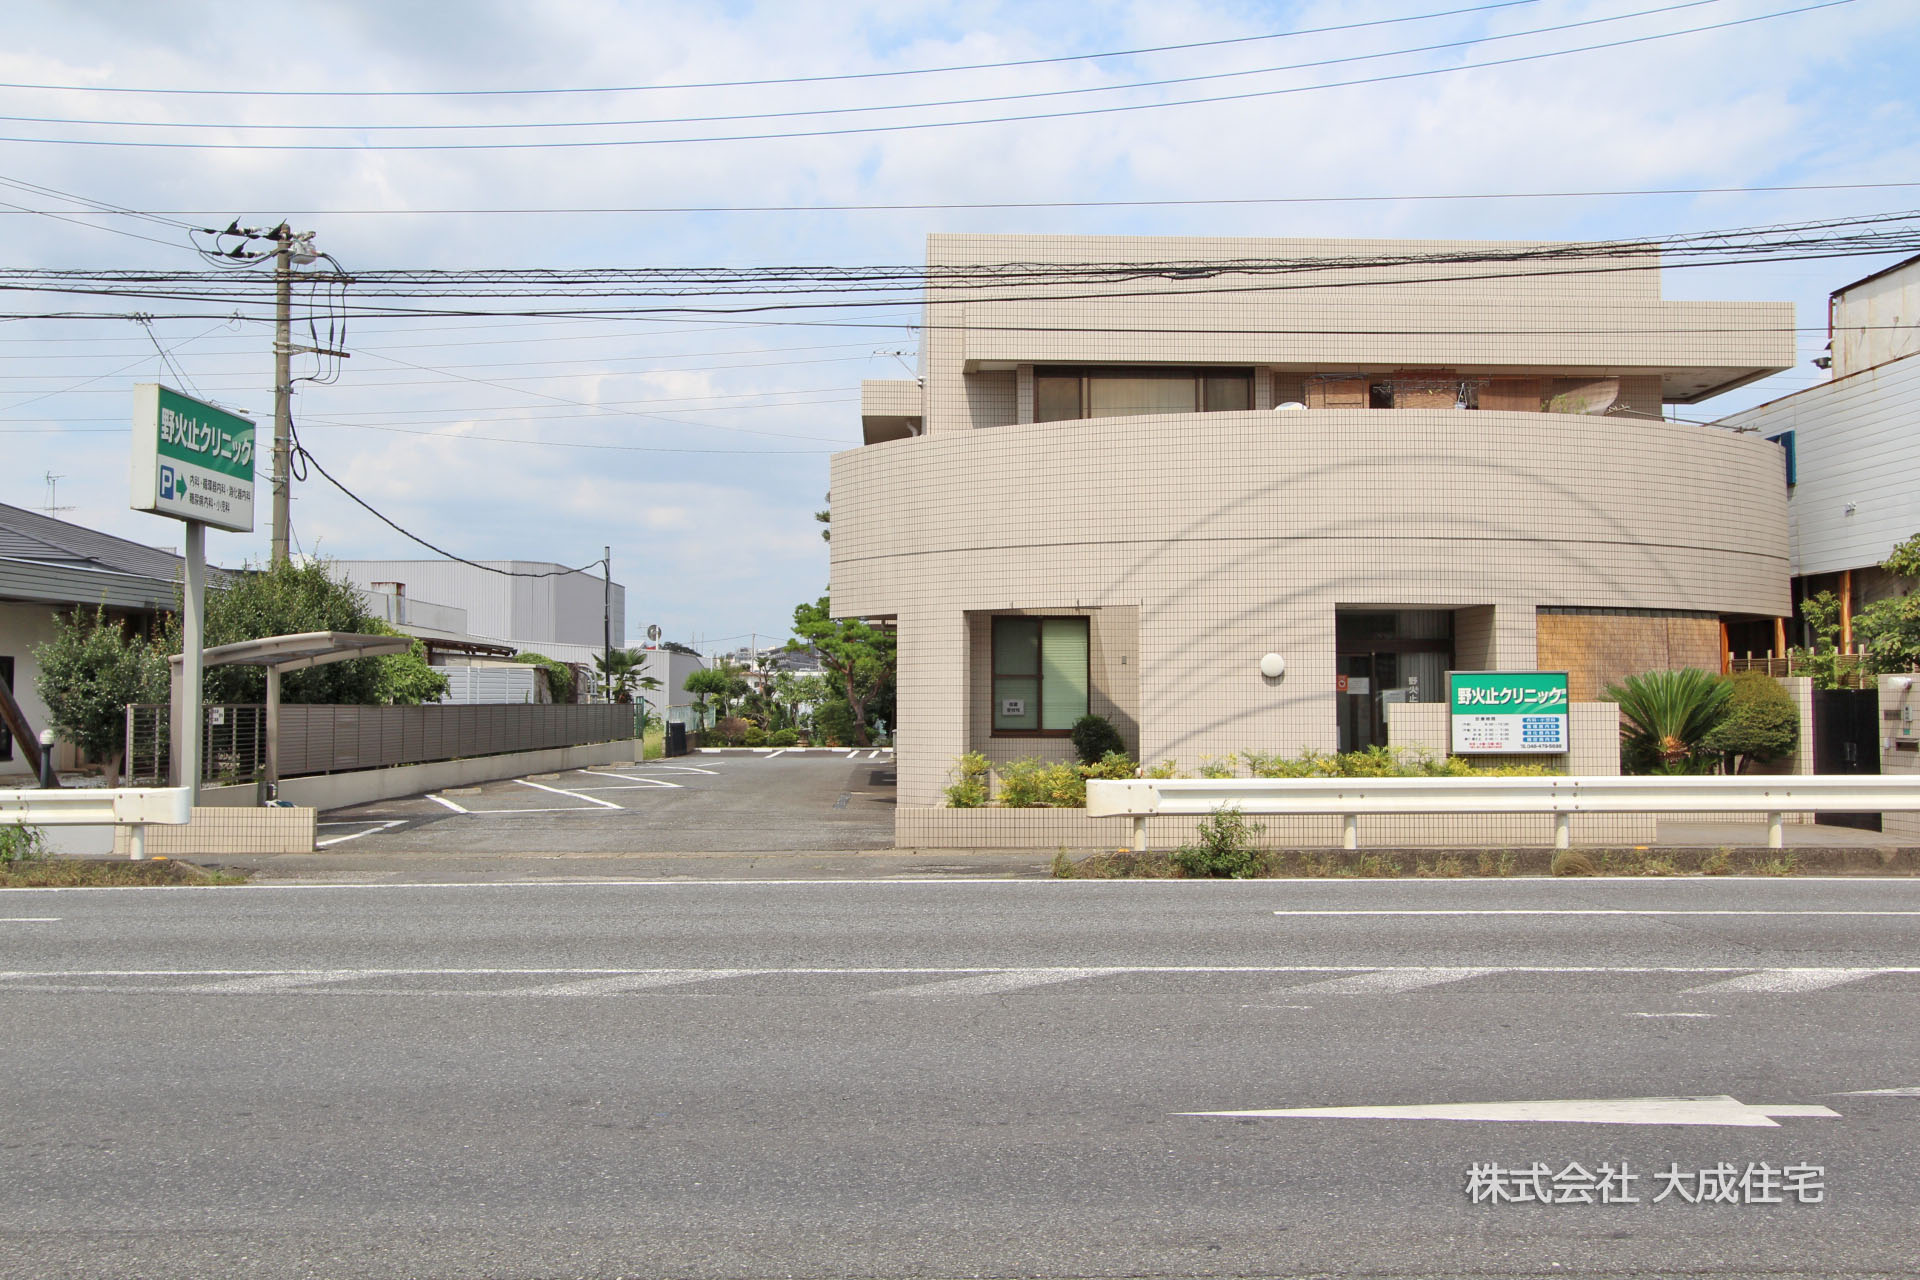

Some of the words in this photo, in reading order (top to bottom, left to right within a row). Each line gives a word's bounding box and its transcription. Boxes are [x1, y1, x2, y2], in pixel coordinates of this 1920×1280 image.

[161, 407, 252, 466] 野火止クリニック
[161, 468, 173, 496] P
[1457, 687, 1562, 705] 野火止クリニック
